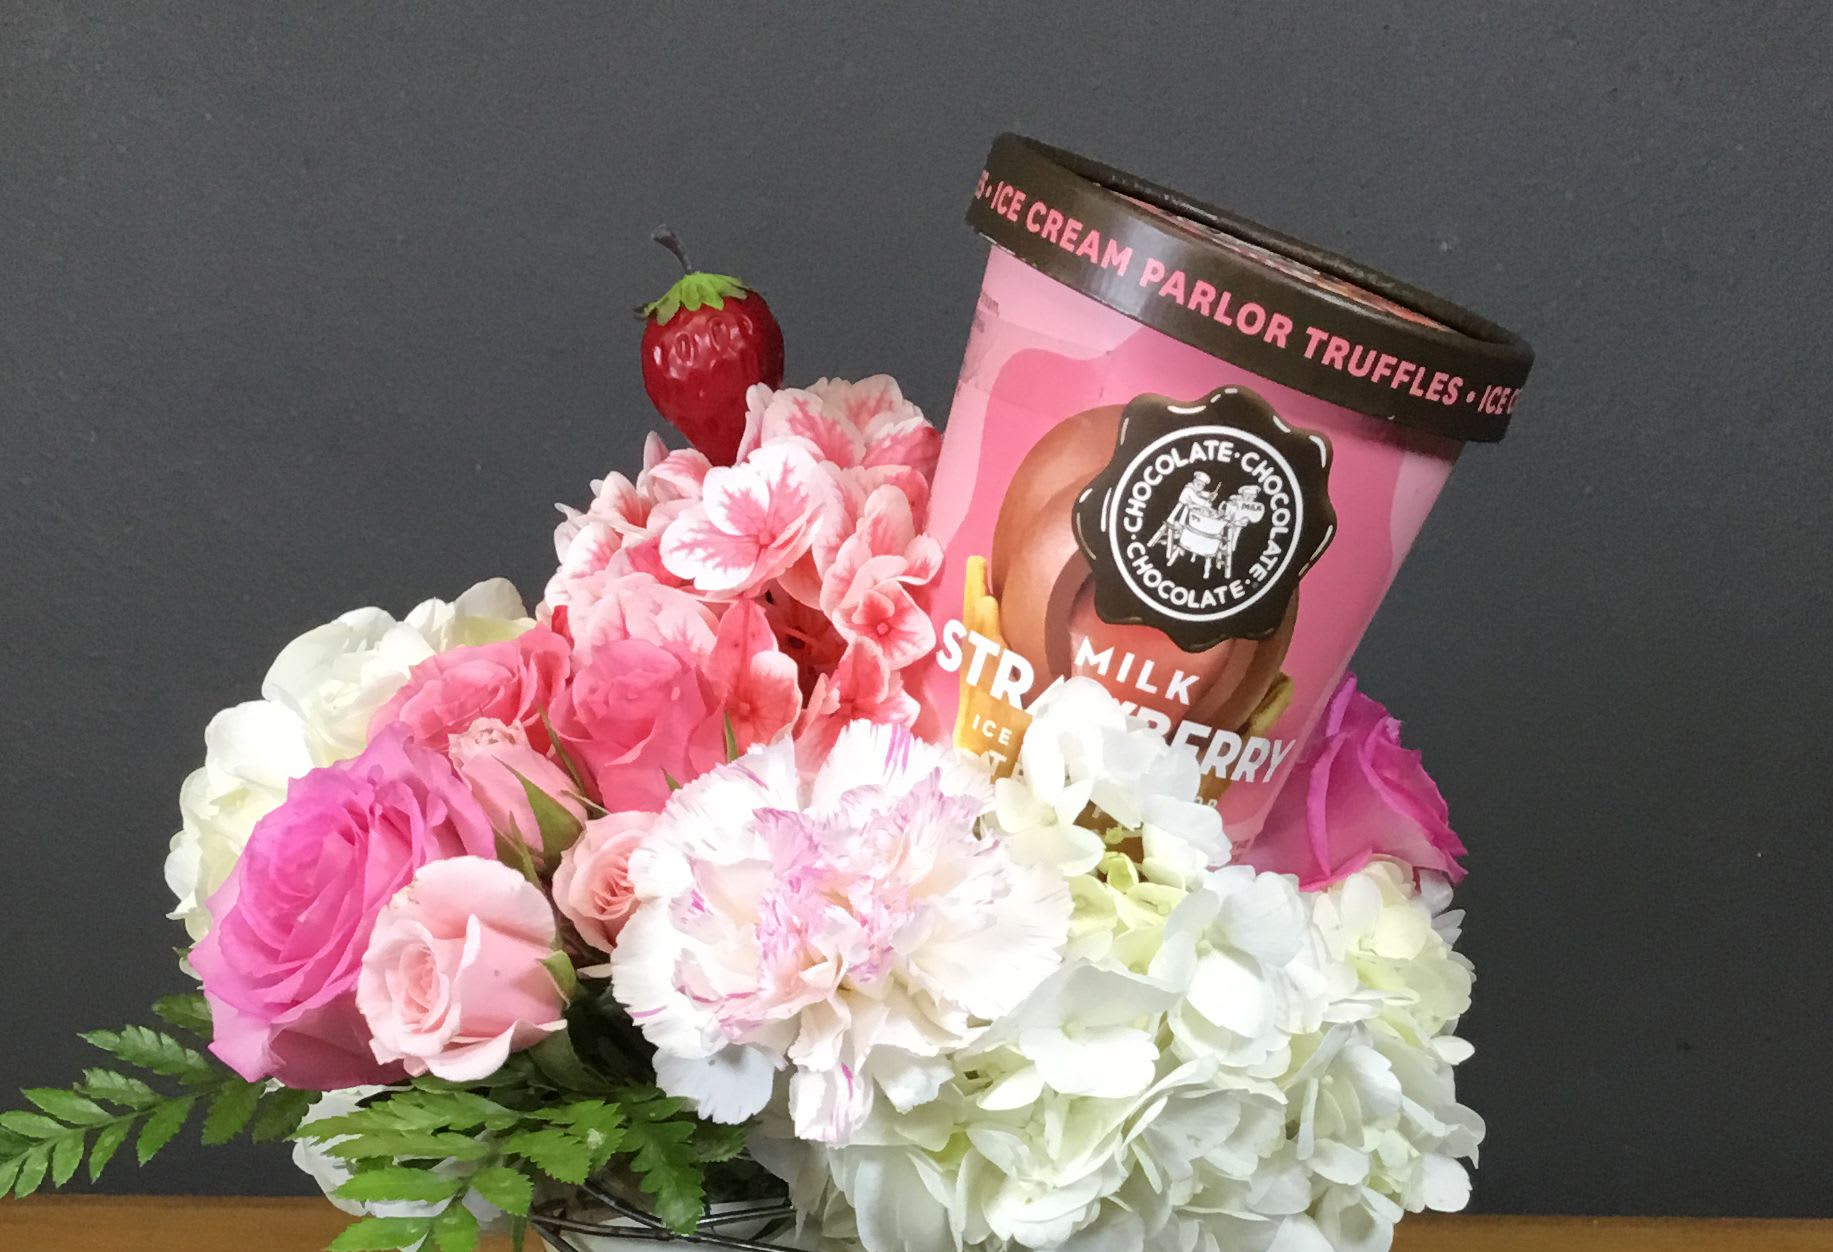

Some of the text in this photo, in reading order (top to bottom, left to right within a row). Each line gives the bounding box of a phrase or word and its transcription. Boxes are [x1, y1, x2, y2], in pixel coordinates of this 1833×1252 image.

[991, 181, 1511, 414] ICE CREAM PARLOR TRUFFLES ICE
[1123, 439, 1291, 609] CHOCOLATE CHOCOLATE CHOCOLATE
[972, 714, 1012, 745] ICE
[1074, 636, 1200, 705] MILK
